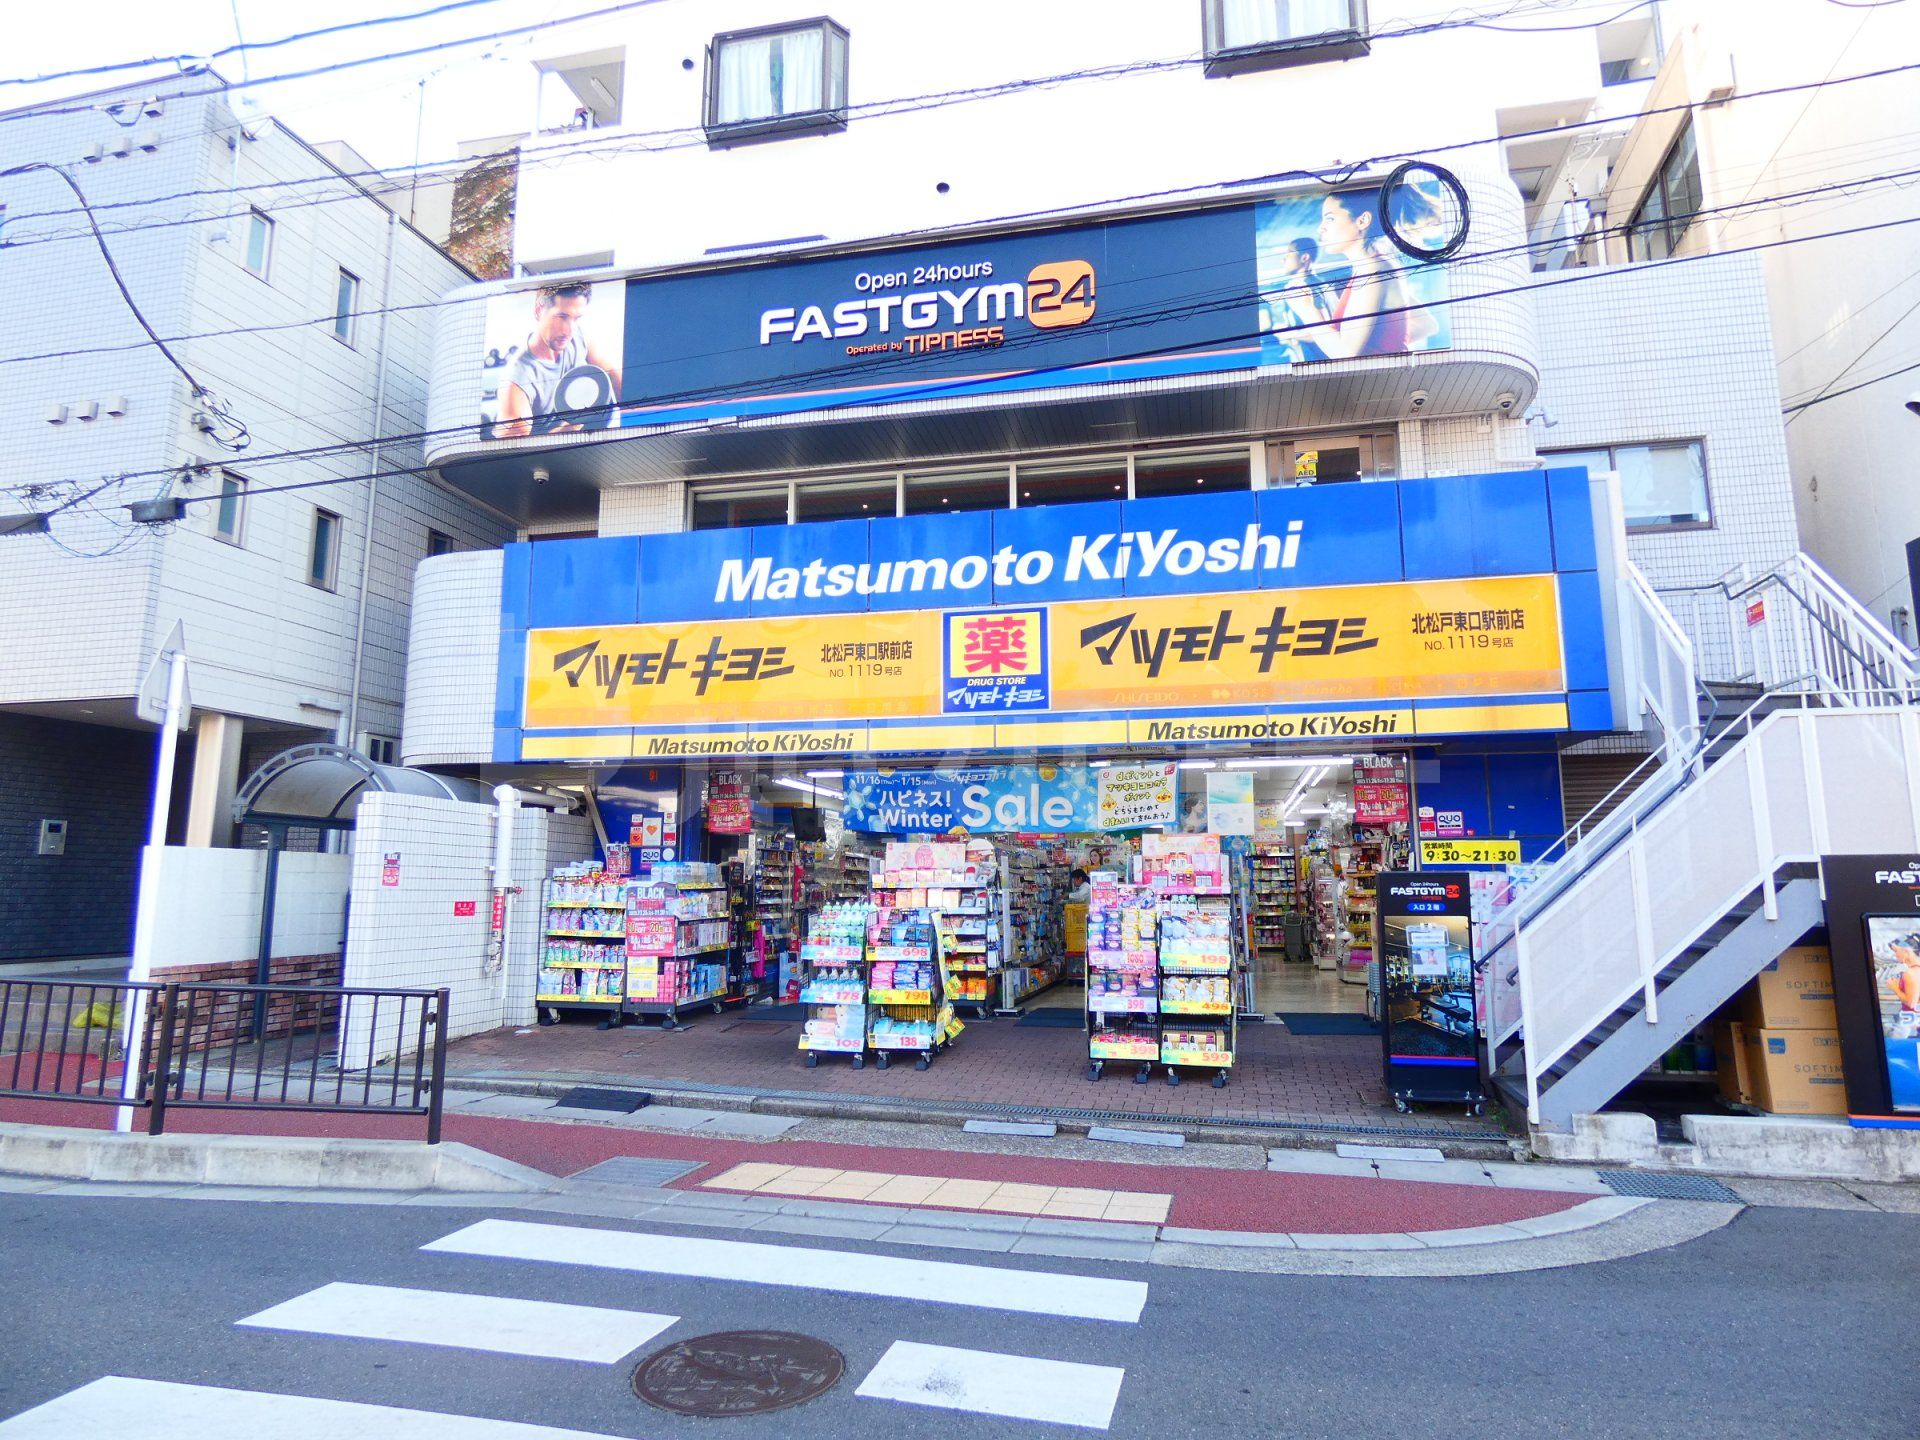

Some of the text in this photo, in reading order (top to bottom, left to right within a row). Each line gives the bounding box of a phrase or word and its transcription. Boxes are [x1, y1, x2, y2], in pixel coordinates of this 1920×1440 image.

[854, 260, 994, 293] Open 24hours
[760, 270, 1096, 346] FASTGYM 24
[846, 326, 1005, 355] Operated by TIPNESS
[713, 520, 1304, 603] Matsumoto KiYoshi
[1411, 608, 1525, 635] 北松戸東口駅前店
[963, 615, 1028, 675] 薬
[1080, 605, 1380, 679] マツモトキヨシ
[820, 640, 914, 664] 北松戸東口駅前店
[553, 635, 796, 699] マツモトキヨシ
[967, 675, 1028, 687] DRUG STORE
[946, 686, 1046, 710] マツモトキヨシ
[1147, 714, 1397, 742] Matsumoto KiYoshi
[648, 732, 855, 756] Matsumoto KiYoshi
[1363, 757, 1394, 768] BLACK
[719, 775, 742, 785] BLACK
[1124, 792, 1151, 803] ポイント
[878, 784, 1074, 828] Winter Sale
[1438, 815, 1461, 824] QUO
[1423, 842, 1453, 850] 営業時間
[642, 852, 660, 860] QUO
[637, 887, 665, 899] BLACK
[1390, 887, 1446, 896] FASTGYM
[836, 947, 860, 957] 328
[902, 948, 928, 957] 698
[1201, 955, 1228, 965] 198
[835, 992, 860, 1000] 178
[905, 991, 929, 1000] 798
[1202, 1002, 1229, 1011] 498
[835, 1039, 861, 1048] 108
[899, 1037, 917, 1047] 138
[1202, 1052, 1230, 1061] 599
